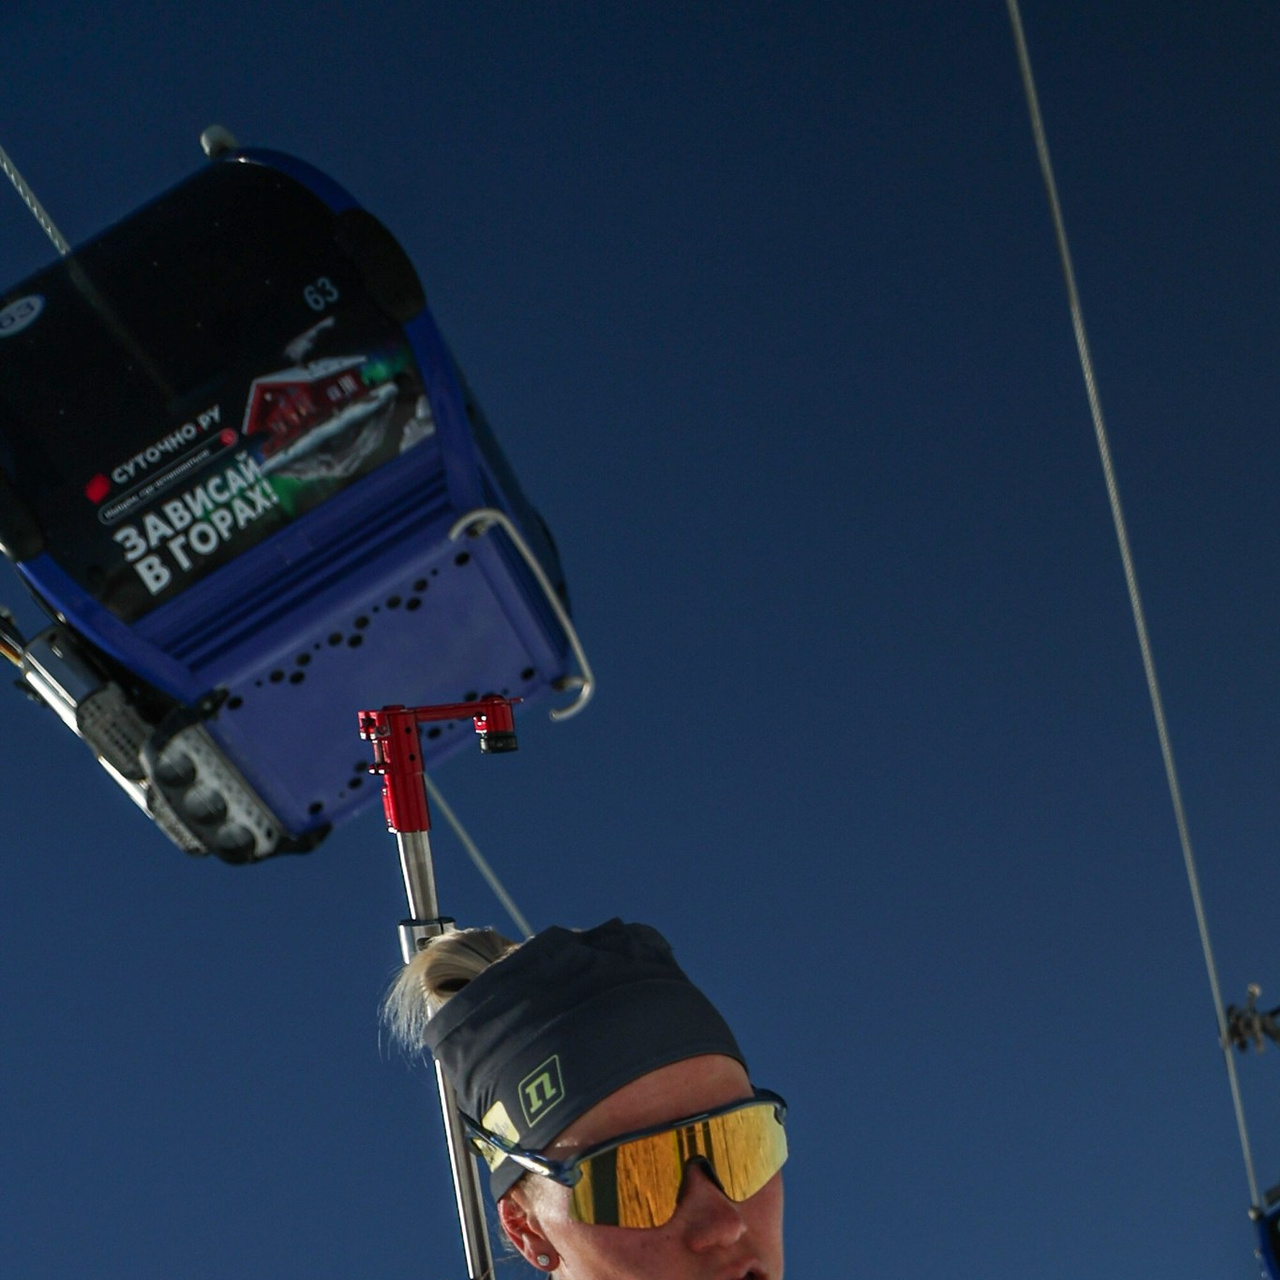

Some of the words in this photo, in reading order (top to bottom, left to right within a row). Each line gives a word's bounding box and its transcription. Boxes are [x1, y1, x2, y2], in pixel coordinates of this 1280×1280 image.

[304, 277, 340, 311] 63
[111, 404, 221, 484] СУТОЧНО.РУ
[113, 450, 263, 562] ЗАВИСАЙ
[134, 553, 171, 595] В
[166, 477, 279, 571] ГОРАХ!
